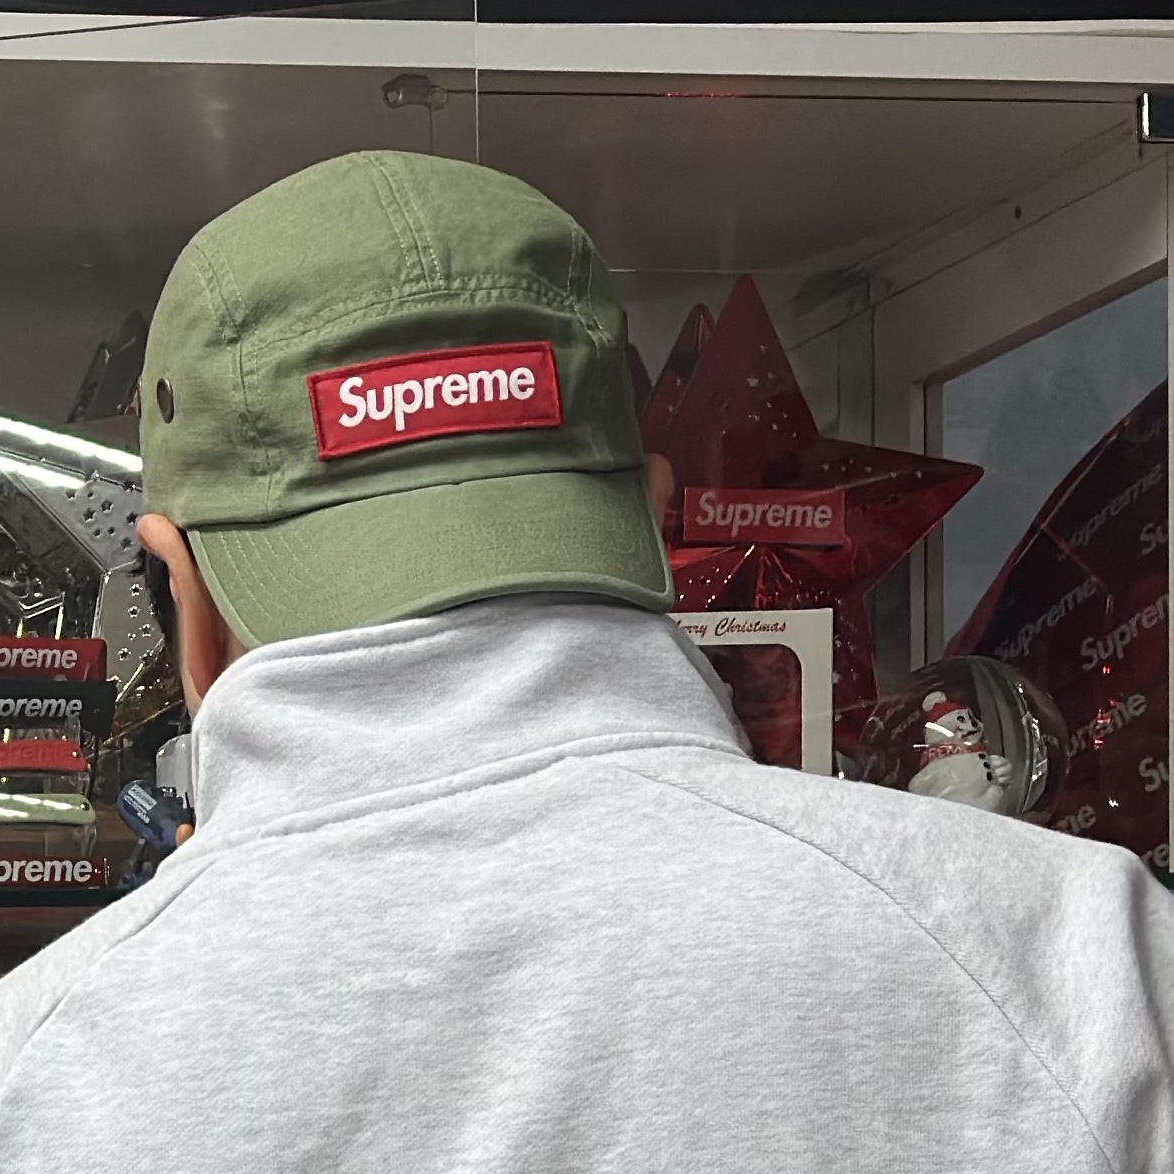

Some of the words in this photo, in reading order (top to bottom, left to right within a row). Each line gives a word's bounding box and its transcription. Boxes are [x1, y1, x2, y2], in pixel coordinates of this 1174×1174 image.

[338, 366, 535, 432] Supreme
[695, 491, 834, 537] Supreme
[1057, 463, 1163, 562] upreme
[675, 619, 708, 638] rry
[714, 616, 787, 637] Christmas
[1079, 593, 1168, 672] Supre
